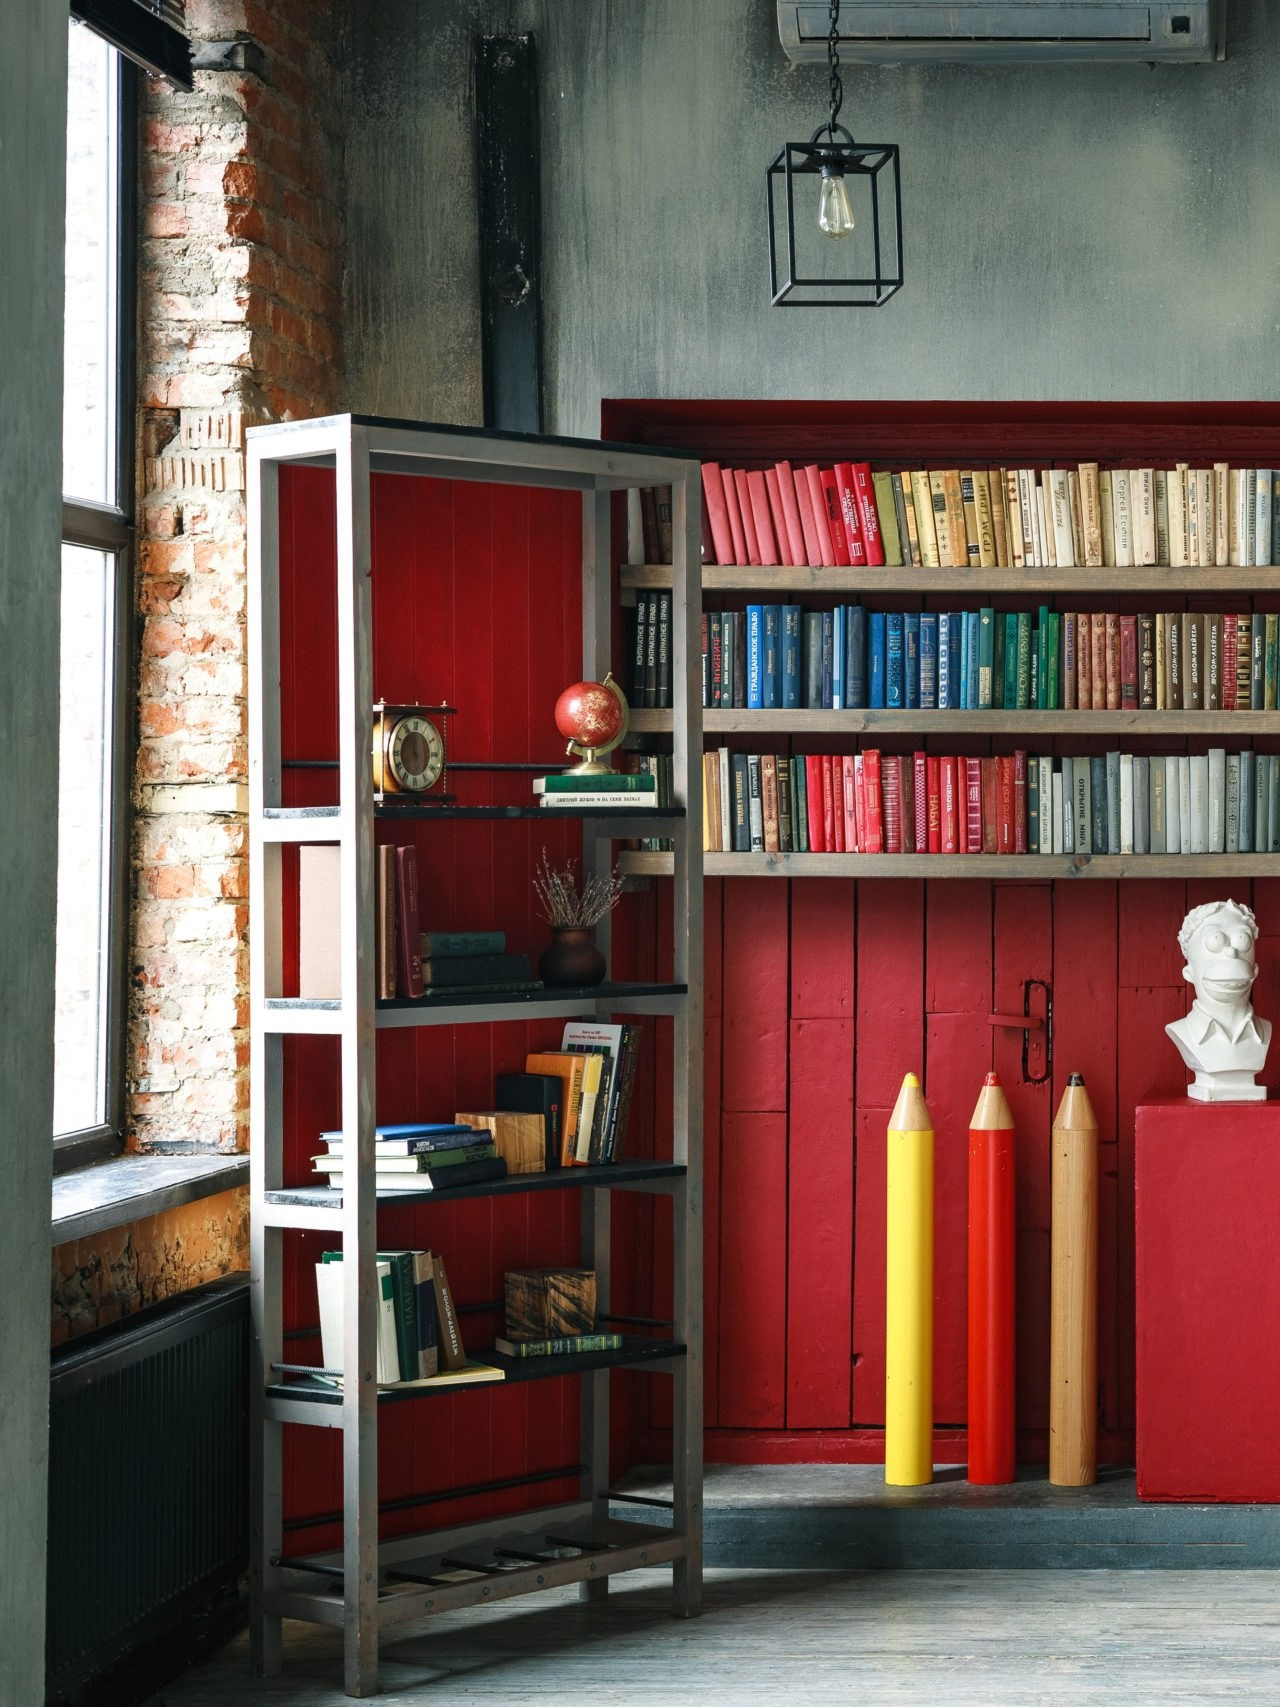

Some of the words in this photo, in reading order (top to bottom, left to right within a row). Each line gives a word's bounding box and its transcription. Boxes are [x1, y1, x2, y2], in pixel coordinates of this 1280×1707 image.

[978, 484, 988, 514] ГРИН
[1116, 479, 1127, 512] Сергей
[980, 521, 992, 553] ГРЭМ
[1119, 513, 1128, 550] Есенин
[637, 602, 645, 623] ПРАВО
[636, 625, 644, 665] КОНТРАКТНОЕ
[647, 626, 656, 667] КОНТРАКТНОЕ
[659, 623, 667, 663] КОНТРАКТНОЕ
[1019, 625, 1028, 662] МИХАИЛ
[1190, 623, 1198, 684] ШОЛОМ-АЛЕЙХЕМ
[1018, 663, 1027, 706] ЛУКОНИН
[929, 793, 939, 834] НАБАТ
[1002, 786, 1010, 803] ВСЕЙ
[1078, 778, 1086, 819] ОТКРЫТИЕ
[1078, 824, 1086, 846] МИРА
[441, 1287, 458, 1356] ШОЛОМ-АЛЕЙХЕМ
